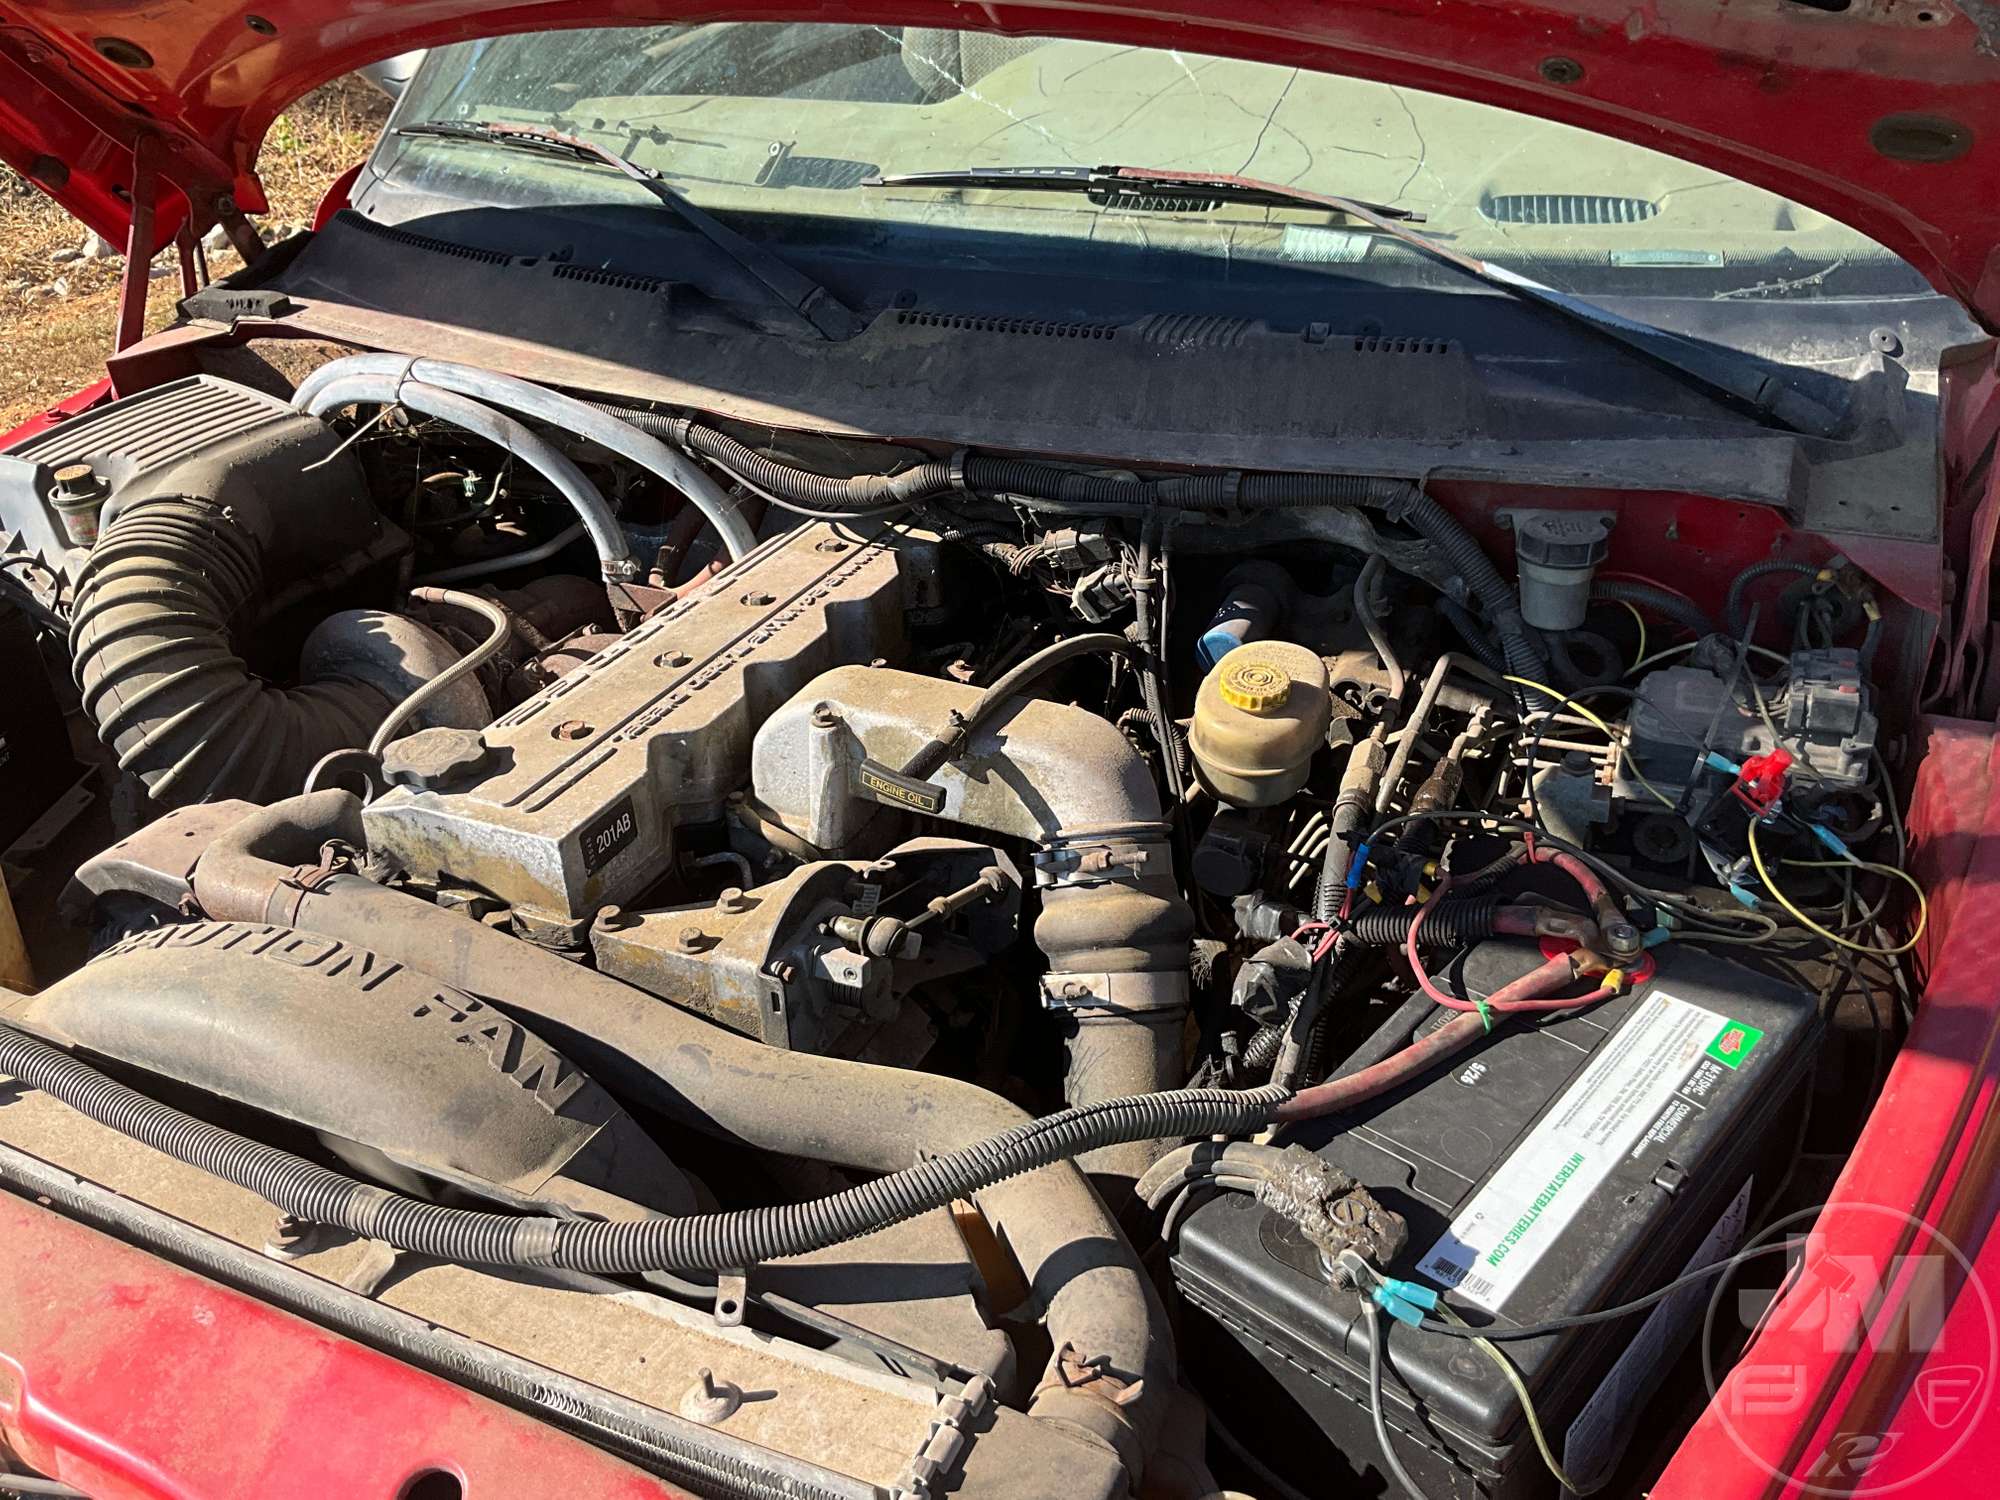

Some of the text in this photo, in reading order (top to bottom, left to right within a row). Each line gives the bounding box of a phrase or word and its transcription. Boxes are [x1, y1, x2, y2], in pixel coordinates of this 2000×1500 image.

[870, 776, 925, 806] ENGINE OIL
[596, 812, 631, 854] 201AB
[1460, 1062, 1487, 1085] 5/26
[1653, 1103, 1691, 1144] COMMERCIAL
[1486, 1151, 1586, 1268] INTERSTATEBATTERIES.COM
